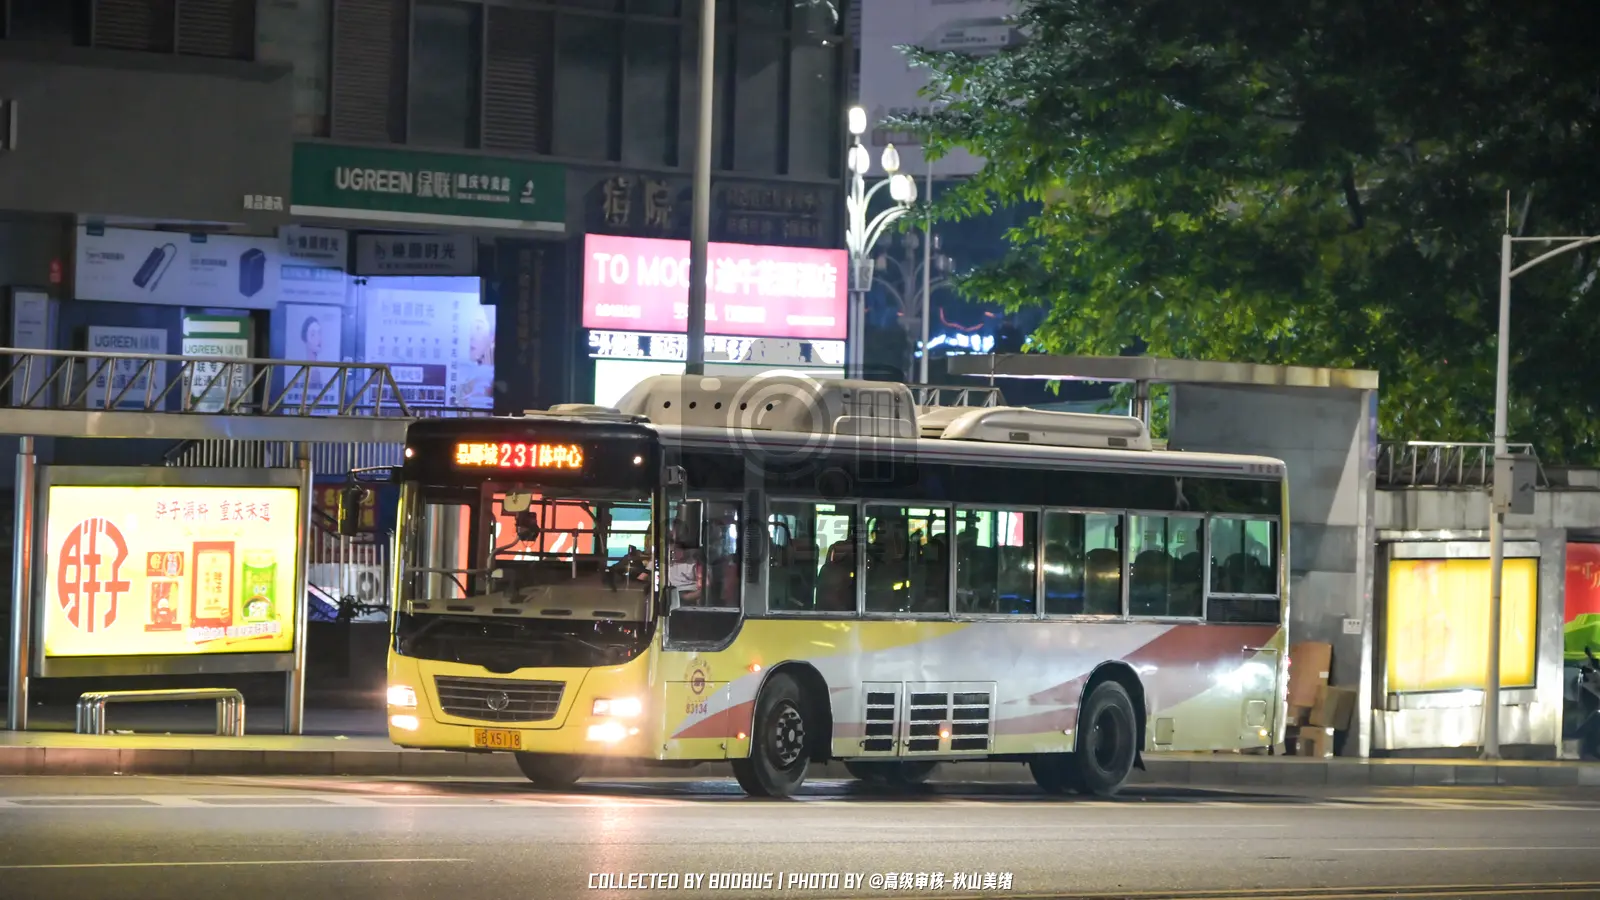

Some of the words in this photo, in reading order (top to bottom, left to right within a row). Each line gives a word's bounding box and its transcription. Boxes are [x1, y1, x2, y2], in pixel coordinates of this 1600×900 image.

[335, 166, 413, 193] UGREEN
[594, 252, 630, 284] TO
[95, 334, 138, 349] UGREEN
[185, 344, 223, 354] UGREEN
[500, 443, 538, 467] 231
